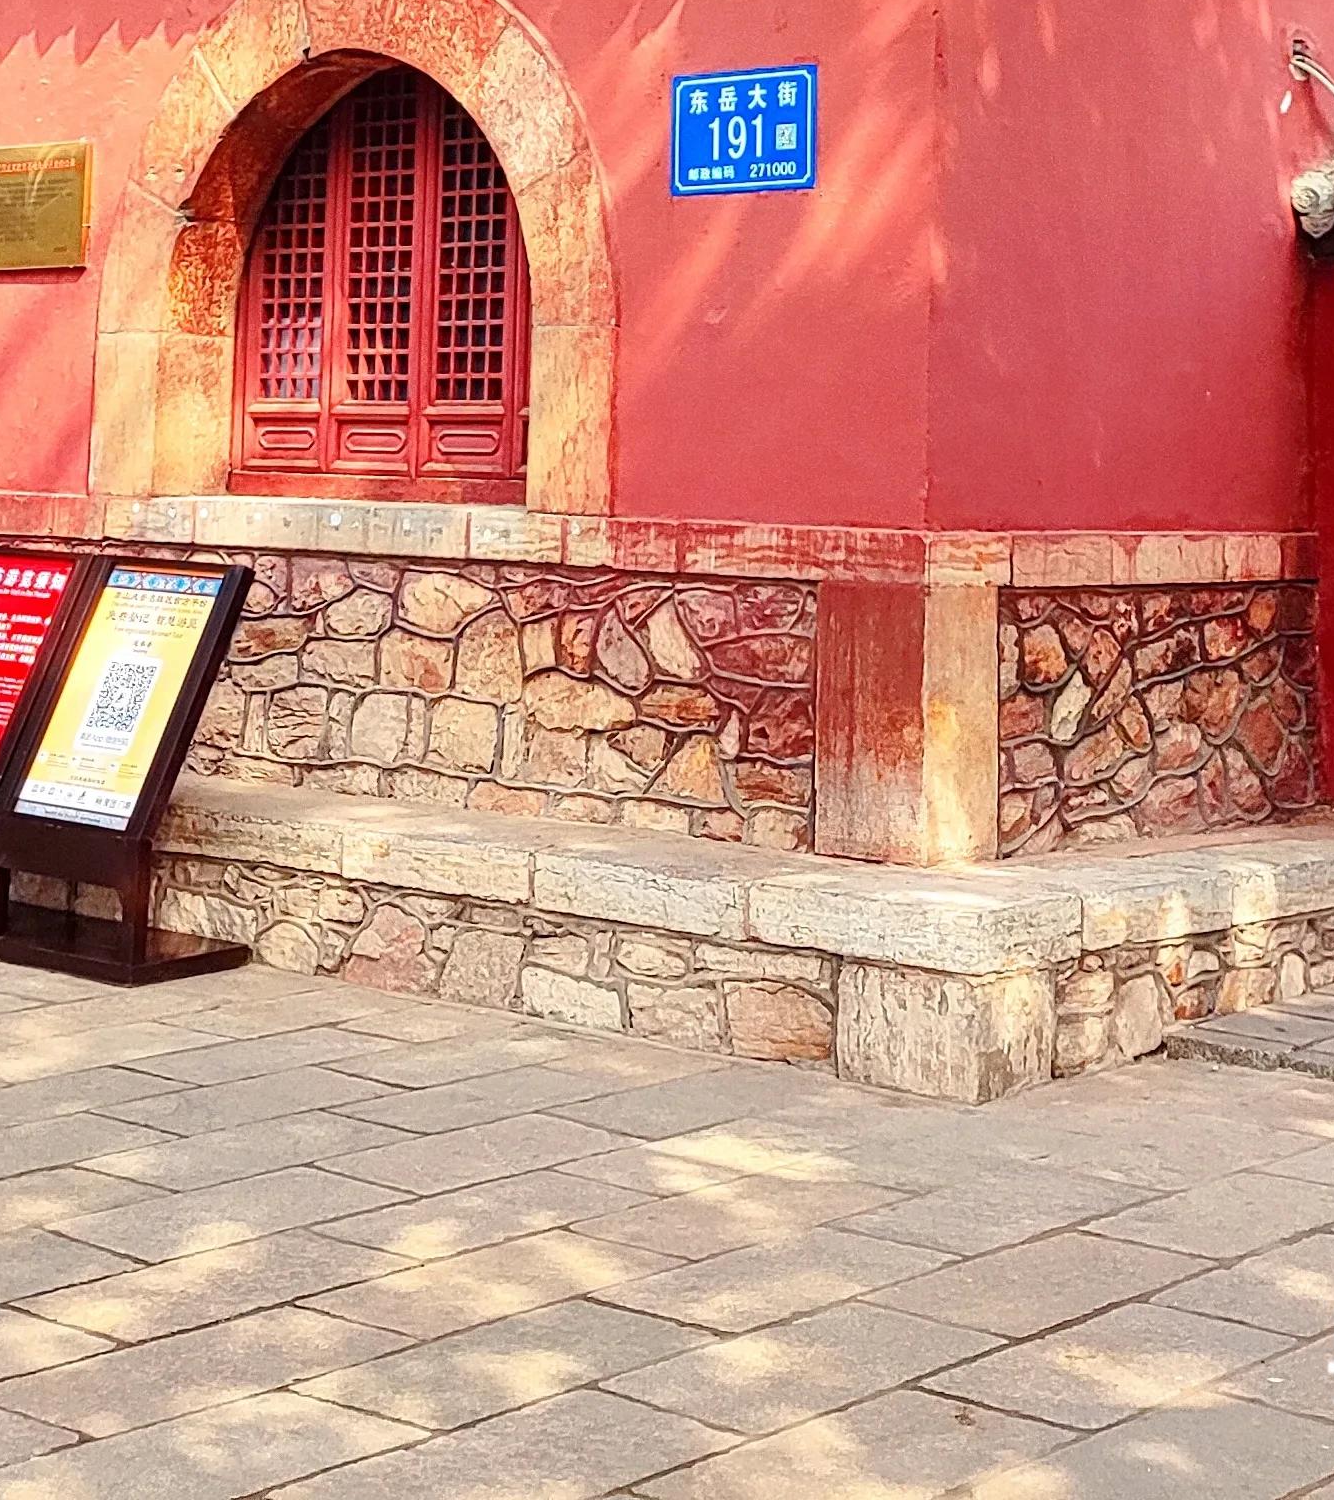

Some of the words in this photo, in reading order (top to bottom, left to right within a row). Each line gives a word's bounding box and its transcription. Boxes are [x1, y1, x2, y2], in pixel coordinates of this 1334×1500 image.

[689, 81, 798, 114] 东岳大街
[708, 114, 764, 161] 191
[688, 165, 735, 181] 邮政编码
[750, 161, 796, 178] 271000
